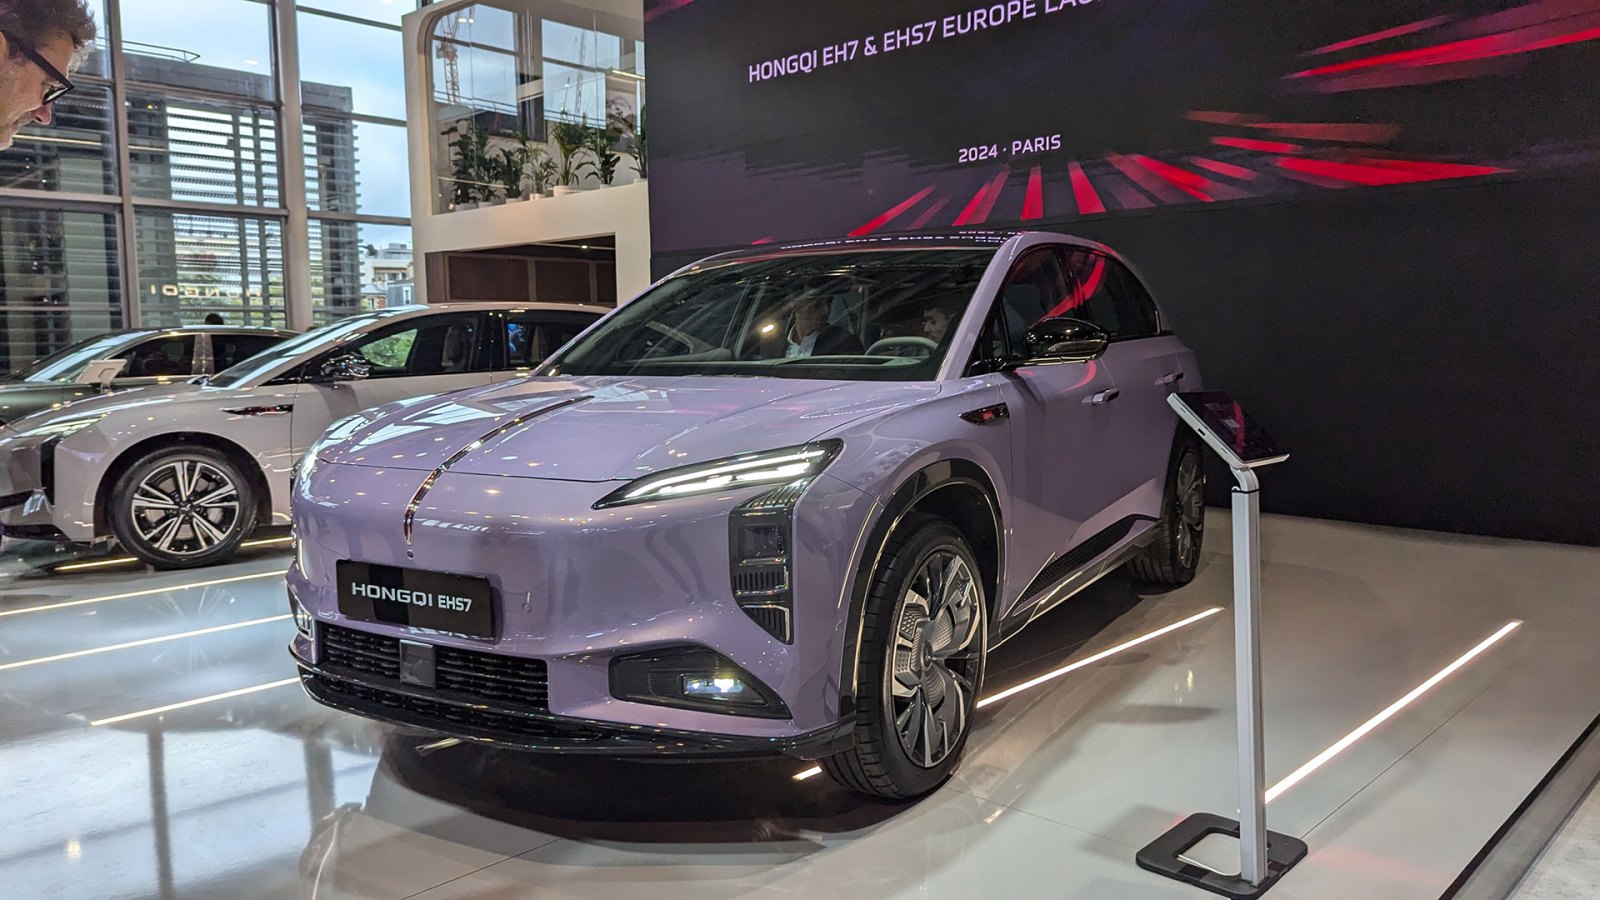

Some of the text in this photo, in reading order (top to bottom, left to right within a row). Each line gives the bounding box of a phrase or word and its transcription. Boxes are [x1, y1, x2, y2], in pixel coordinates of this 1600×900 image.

[749, 49, 817, 83] HONGQI
[823, 40, 859, 66] EH7
[864, 36, 878, 56] &
[884, 20, 937, 52] EHS7
[943, 0, 1037, 38] EUROPE
[959, 144, 998, 163] 2024
[1012, 134, 1061, 155] PARIS
[352, 582, 472, 612] HONGQI EHS7
